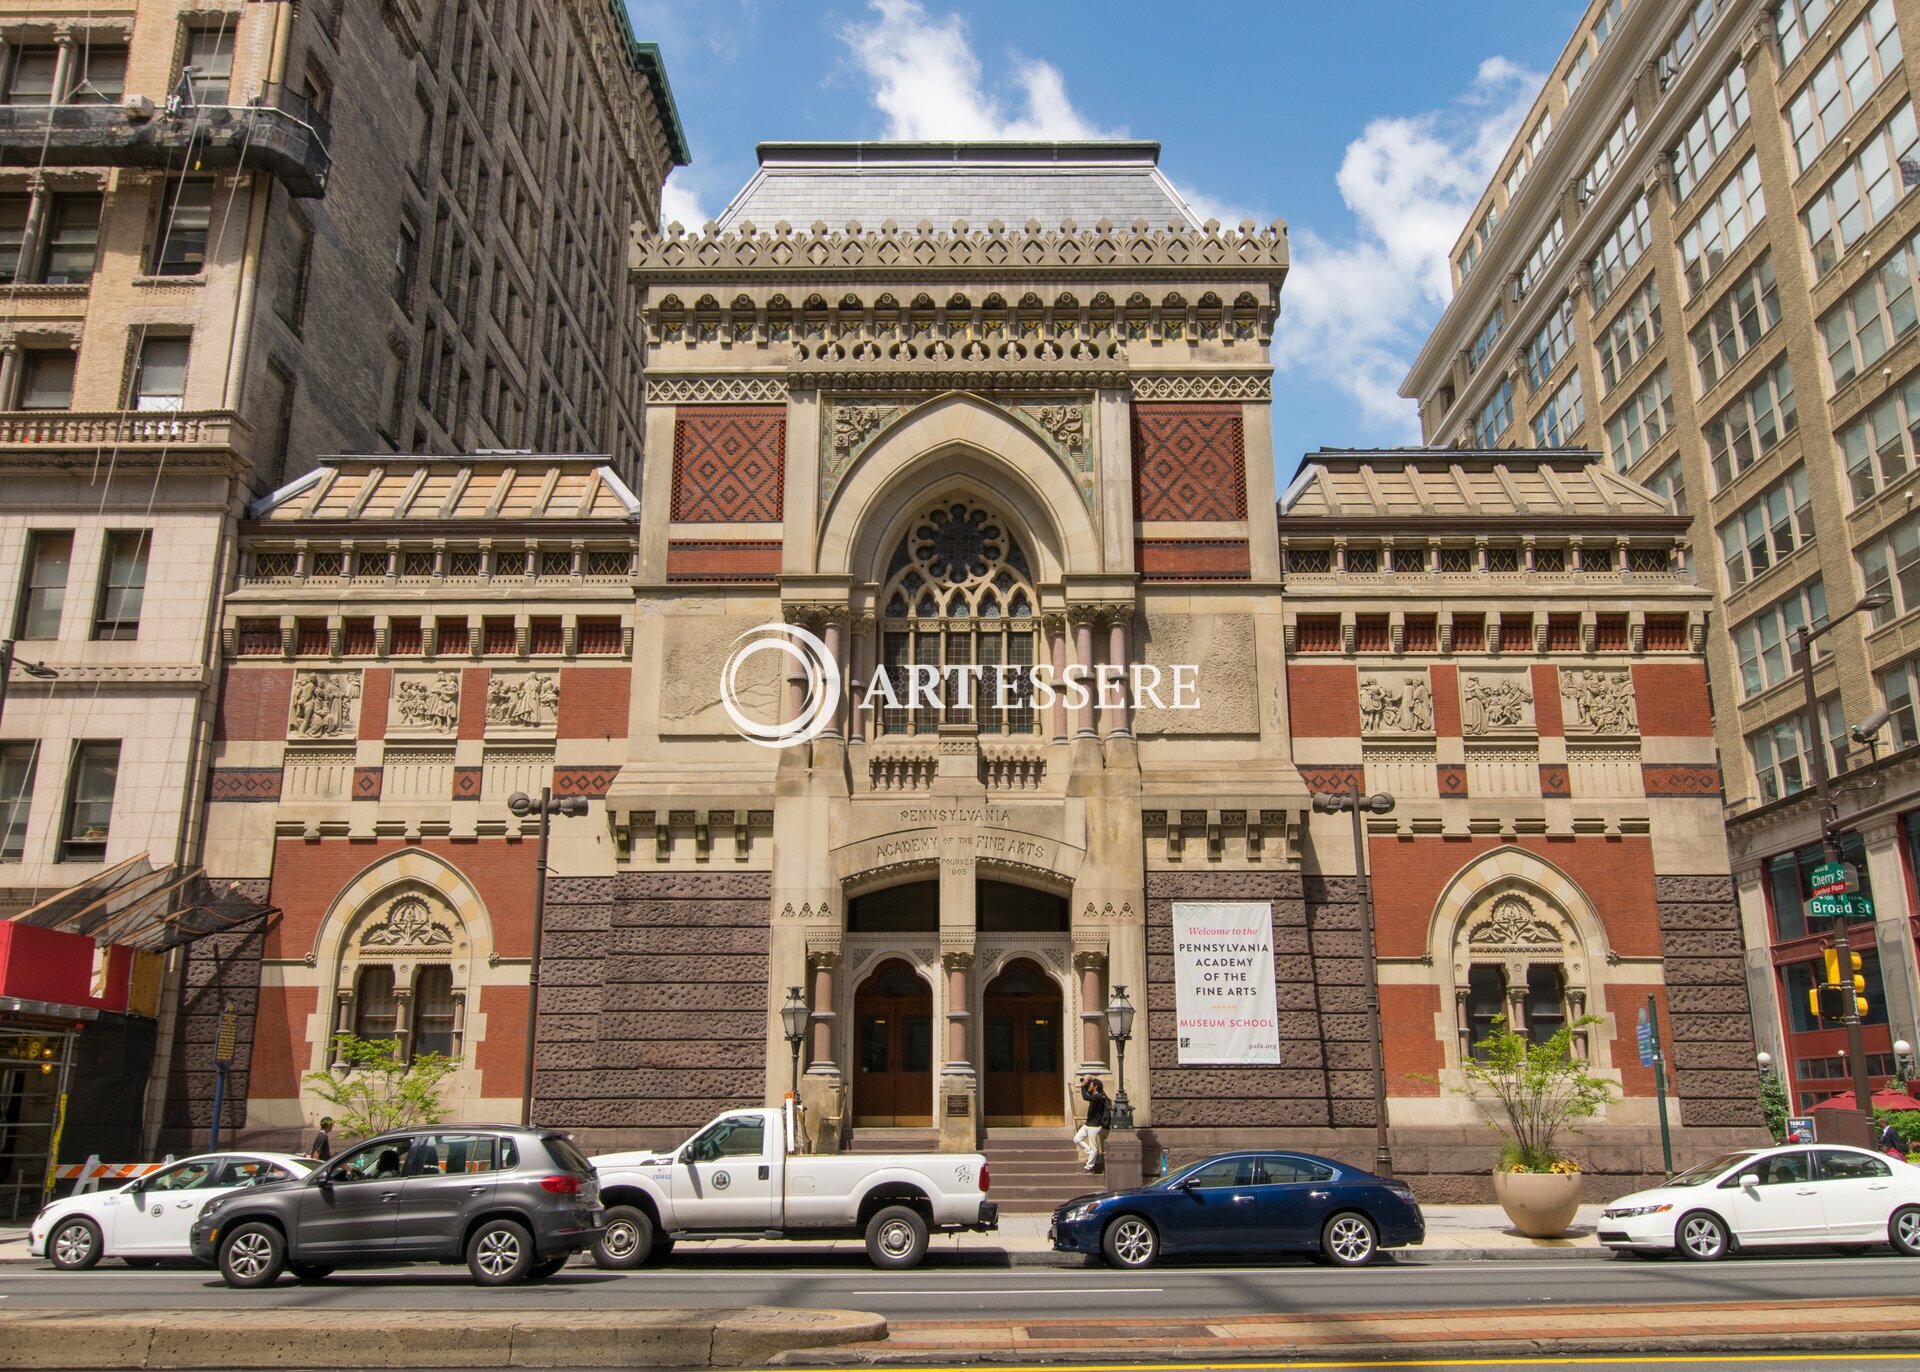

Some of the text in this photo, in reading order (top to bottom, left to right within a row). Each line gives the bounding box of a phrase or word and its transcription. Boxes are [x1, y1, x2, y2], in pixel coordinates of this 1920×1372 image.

[900, 809, 1011, 822] PENNSYLVANIA
[876, 835, 1045, 859] ACADEMY OF THE FINE ARTS
[948, 868, 968, 876] 1805
[1812, 869, 1845, 887] Cherry St
[1831, 884, 1844, 892] Plaza
[1812, 901, 1871, 914] Broad St
[1188, 927, 1258, 936] Welcome to the
[1179, 943, 1269, 953] PENNSYLVANIA
[1195, 957, 1254, 967] ACADEMY
[1203, 972, 1247, 982] OF THE
[1196, 987, 1257, 996] FINE ARTS
[1180, 1019, 1274, 1028] MUSEUM SCHOOL
[1248, 1042, 1277, 1050] pafa.org
